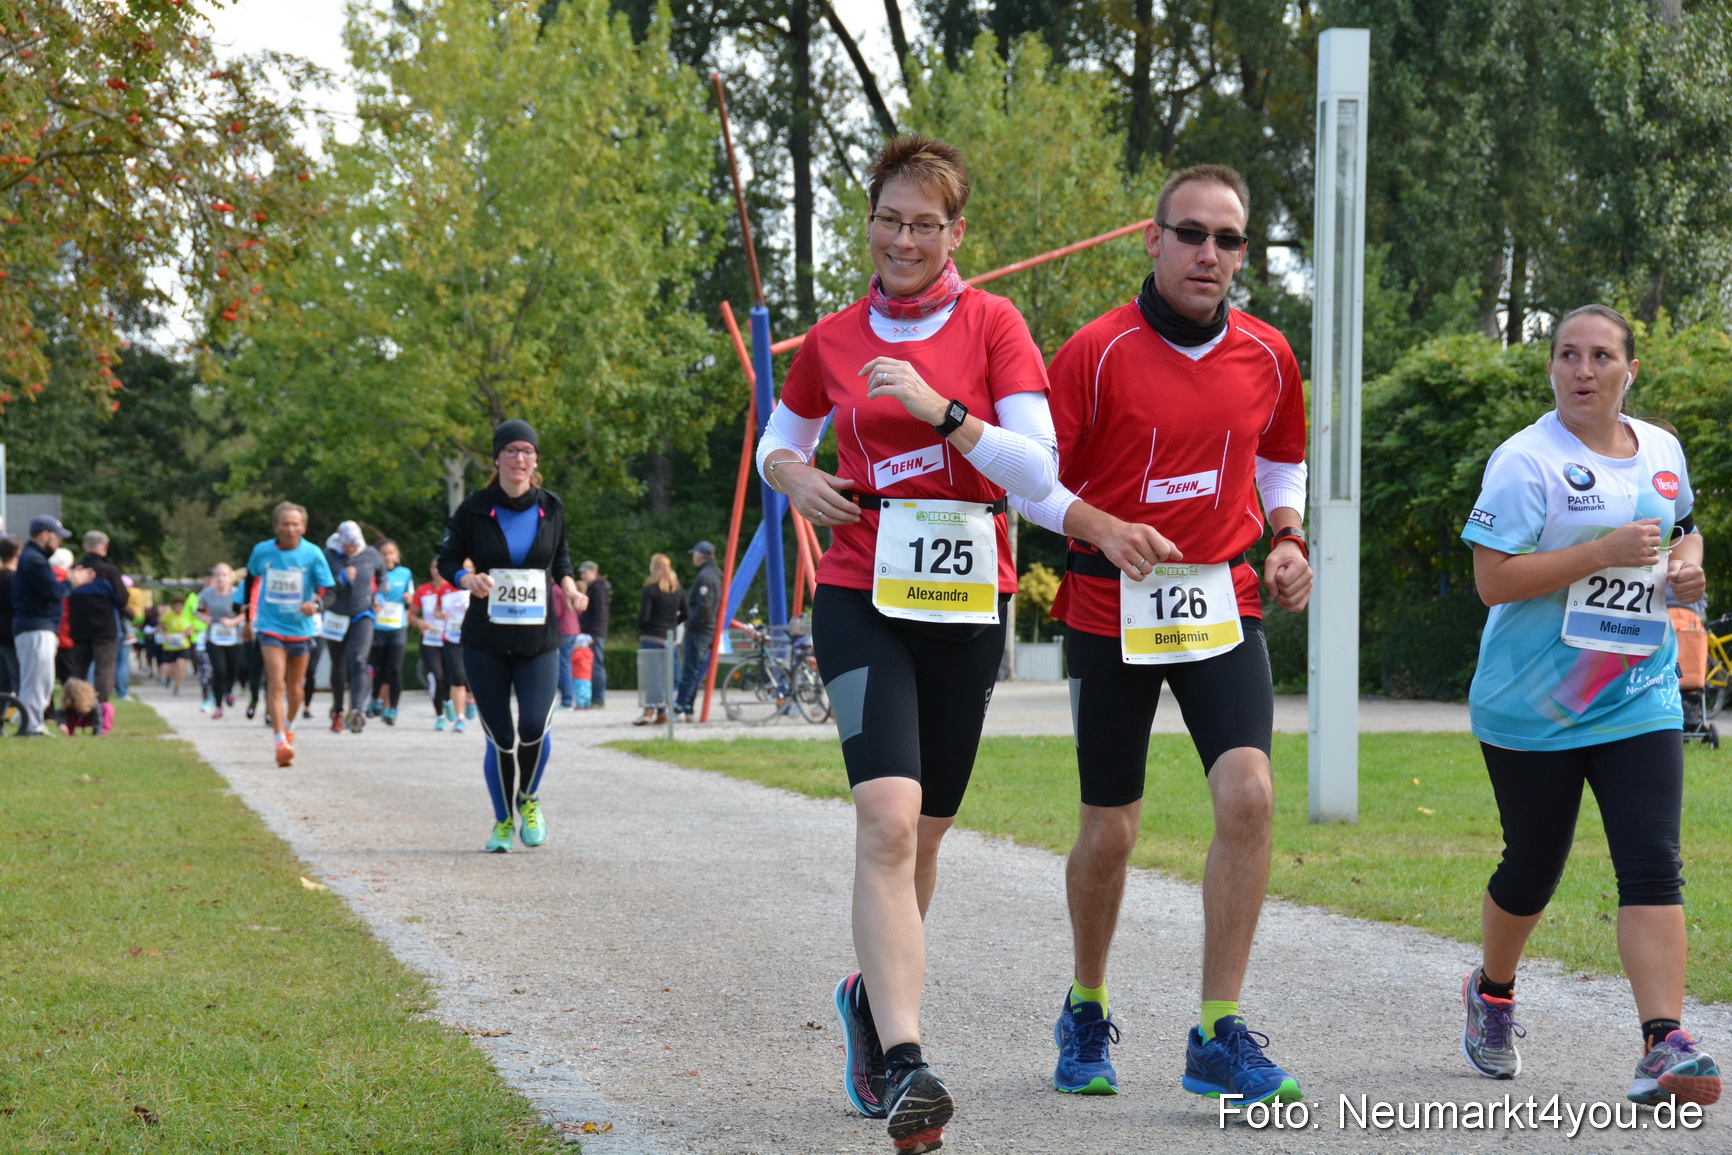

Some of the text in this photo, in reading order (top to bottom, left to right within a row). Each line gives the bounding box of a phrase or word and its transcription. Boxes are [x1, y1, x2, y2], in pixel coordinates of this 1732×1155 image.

[891, 456, 924, 476] DEHN
[1166, 480, 1199, 495] DEHN
[1567, 495, 1605, 505] PARTL
[1568, 504, 1606, 512] Neumarkt
[928, 511, 968, 523] BOCK
[909, 537, 973, 576] 125
[498, 586, 536, 602] 2494
[907, 586, 968, 602] Alexandra
[1585, 575, 1655, 614] 2221
[1150, 586, 1208, 620] 126
[1600, 620, 1640, 636] Melanie
[1155, 631, 1209, 645] Benjamin
